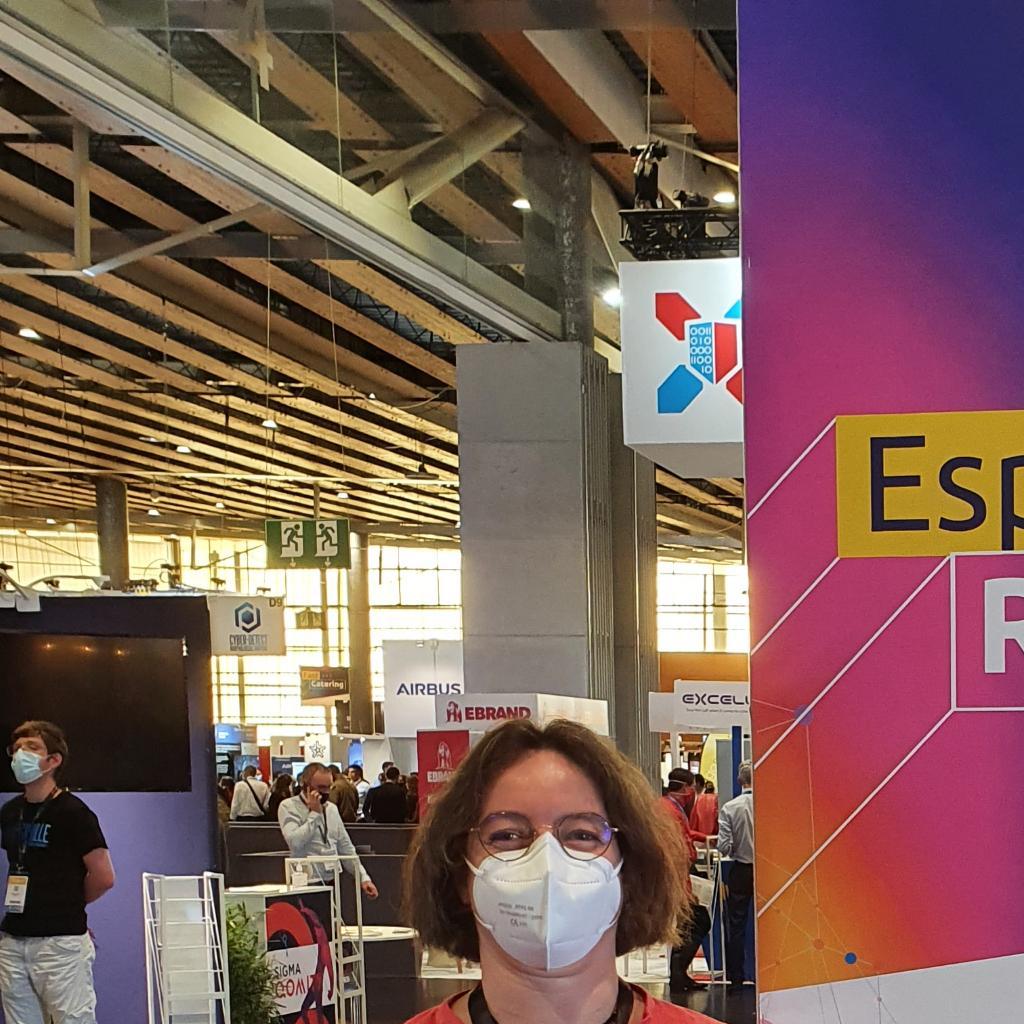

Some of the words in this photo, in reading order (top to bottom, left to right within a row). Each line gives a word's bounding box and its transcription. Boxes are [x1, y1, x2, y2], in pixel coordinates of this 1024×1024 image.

[396, 682, 461, 696] AIRBUS
[464, 705, 532, 722] EBRAND
[274, 963, 302, 977] SIGMA
